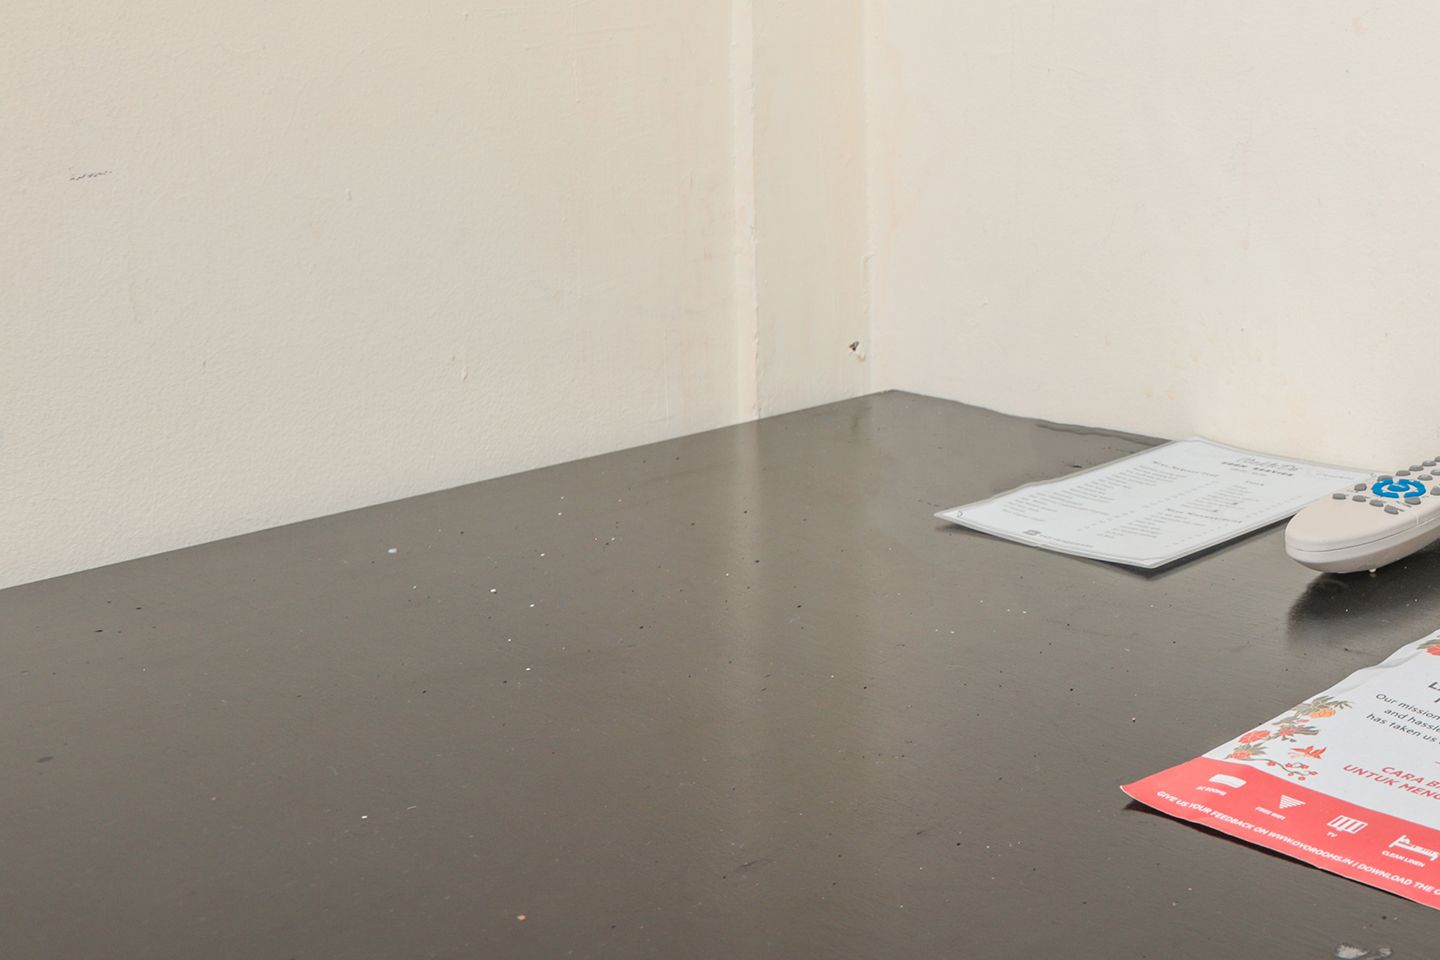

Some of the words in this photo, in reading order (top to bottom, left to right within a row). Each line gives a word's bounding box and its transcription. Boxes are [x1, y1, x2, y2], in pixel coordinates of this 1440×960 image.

[1375, 693, 1398, 705] Our
[1398, 702, 1440, 721] mission
[1384, 708, 1409, 721] and
[1366, 713, 1388, 725] has
[1389, 721, 1422, 737] taken
[1423, 734, 1436, 743] us
[1343, 764, 1401, 787] UNTUK
[1381, 766, 1425, 784] CARA
[1156, 790, 1178, 803] GIVE
[1175, 798, 1189, 808] US
[1187, 801, 1213, 815] YOUR
[1210, 809, 1255, 830] FEEDBACK
[1253, 825, 1269, 835] ON
[1357, 863, 1413, 886] DOWNLOAD
[1414, 881, 1435, 893] THE
[1381, 850, 1406, 862] CLEAN
[1404, 858, 1427, 868] LINEN
